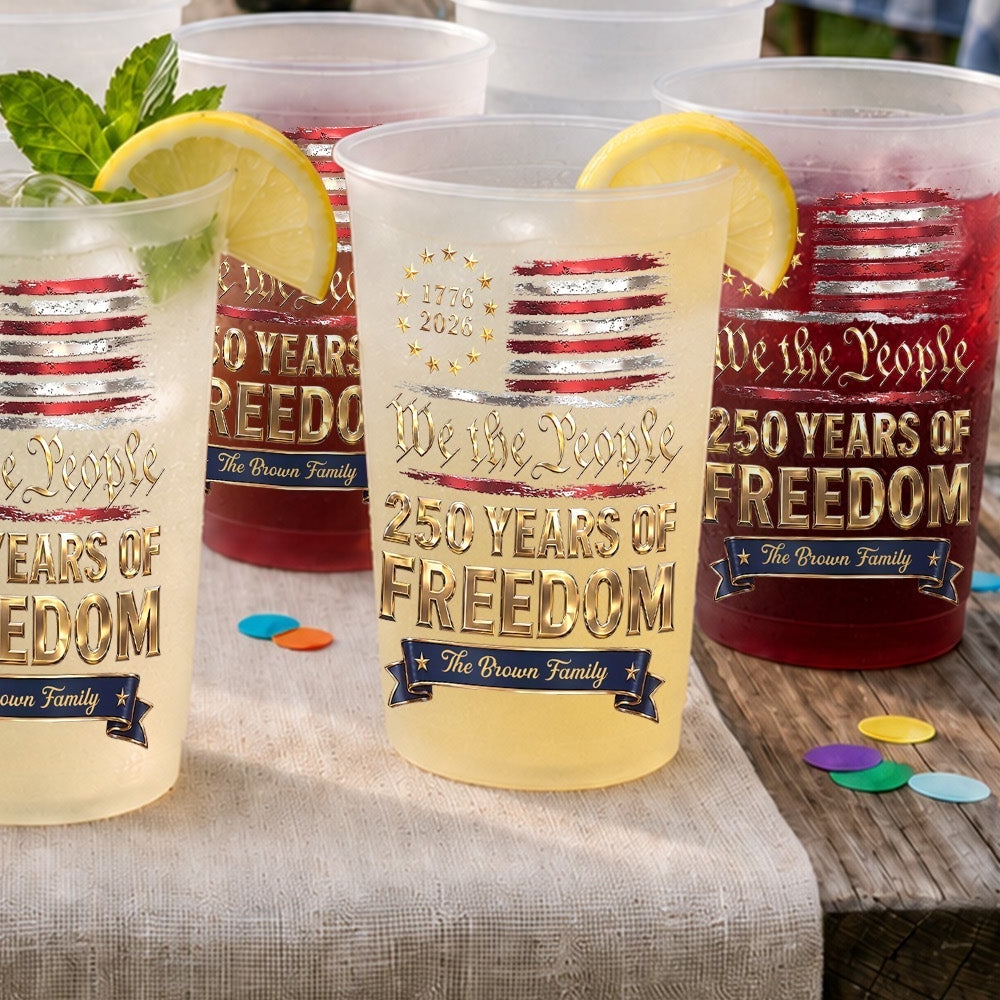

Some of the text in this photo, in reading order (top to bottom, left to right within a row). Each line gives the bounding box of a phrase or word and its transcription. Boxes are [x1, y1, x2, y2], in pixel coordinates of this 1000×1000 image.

[218, 257, 236, 299] e
[422, 283, 474, 309] 1776
[419, 310, 473, 336] 2026
[714, 321, 975, 395] We the People
[209, 377, 365, 444] REEDO
[707, 407, 971, 459] 250 YEARS OF
[386, 393, 682, 488] We the People
[22, 430, 166, 508] People
[218, 453, 357, 486] The Brown Family
[702, 461, 972, 530] FREEDOM
[383, 491, 677, 559] 250 YEARS OF
[119, 526, 161, 579] OF
[761, 543, 912, 573] The Brown Family
[378, 550, 676, 639] FREEDOM
[441, 650, 608, 688] The Brown Family
[40, 686, 100, 715] Family
